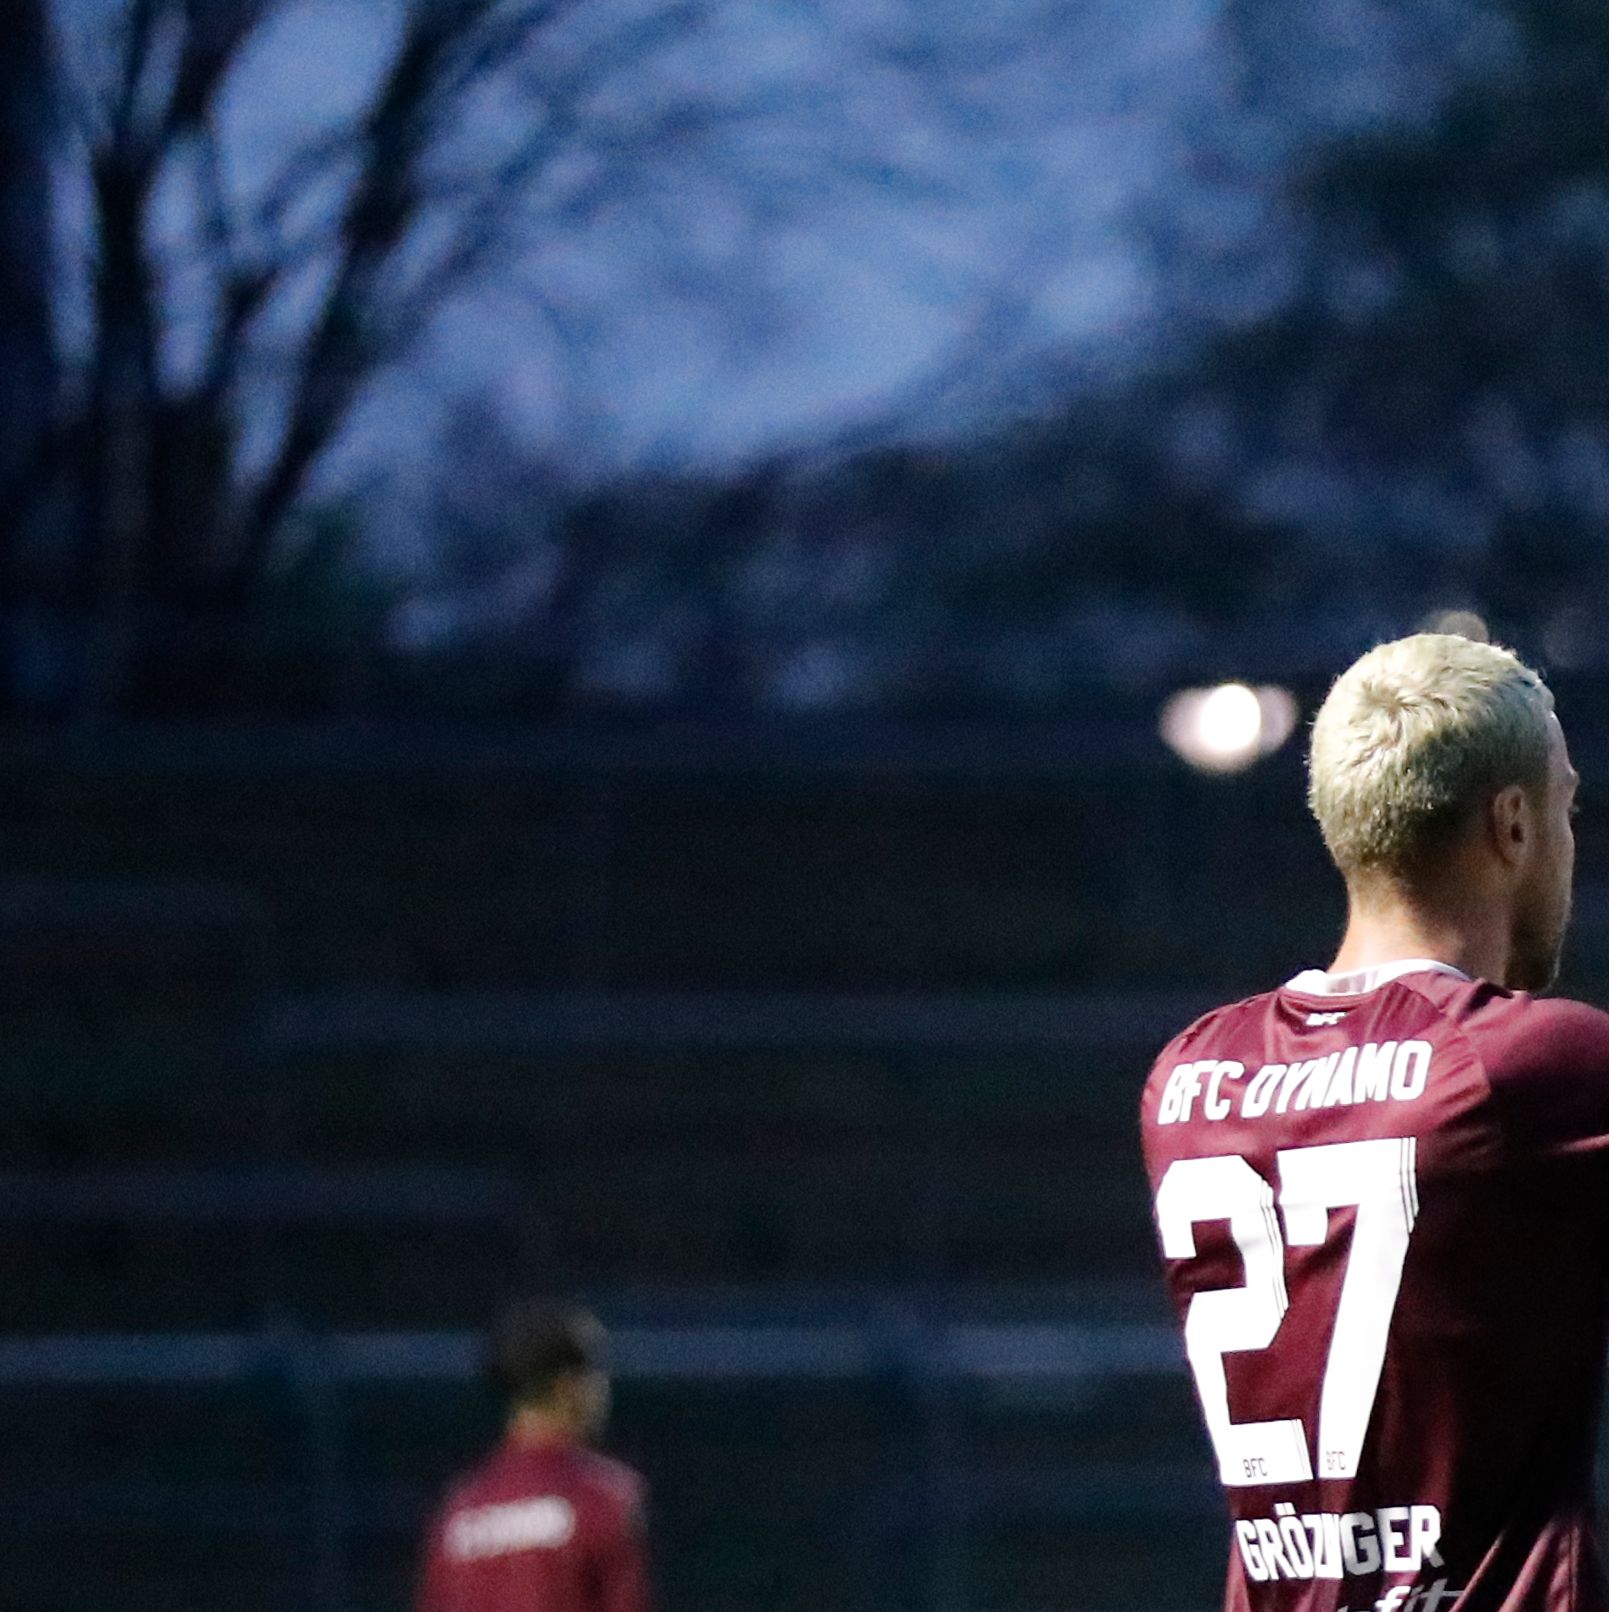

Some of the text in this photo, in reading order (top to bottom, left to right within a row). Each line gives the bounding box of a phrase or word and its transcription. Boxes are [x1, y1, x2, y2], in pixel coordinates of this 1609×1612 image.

[1157, 1039, 1433, 1126] BFC DYNAMO
[1155, 1135, 1420, 1488] 27
[1242, 1457, 1269, 1479] BFC
